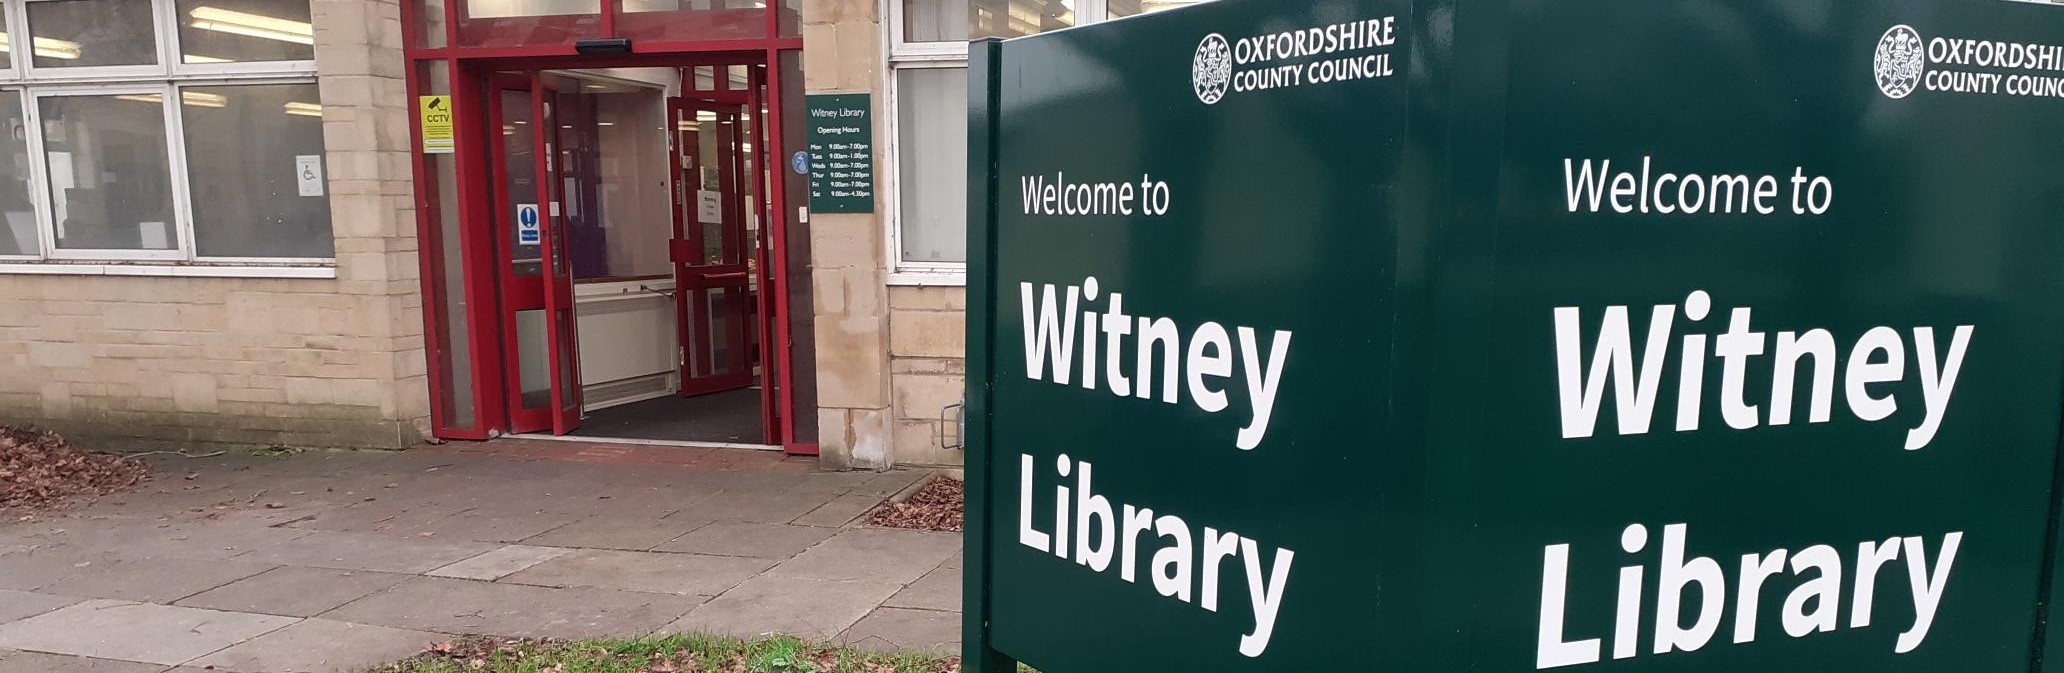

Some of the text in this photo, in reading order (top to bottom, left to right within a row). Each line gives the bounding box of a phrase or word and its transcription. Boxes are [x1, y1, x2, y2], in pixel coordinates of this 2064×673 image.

[1234, 16, 1395, 65] OXFORDSHIRE
[1928, 37, 2064, 71] OXFORDSHI
[1234, 54, 1394, 92] COUNTY COUNCIL
[1925, 70, 2002, 94] COUNTY
[426, 114, 450, 123] CCTV
[811, 107, 865, 119] Witney Library
[817, 126, 842, 135] Opening
[1021, 170, 1170, 216] Welcome to
[1564, 156, 1833, 215] Welcome to
[1020, 276, 1293, 451] Witney
[1553, 289, 1975, 451] Witney
[1019, 453, 1295, 658] Library
[1536, 522, 1964, 670] Library
